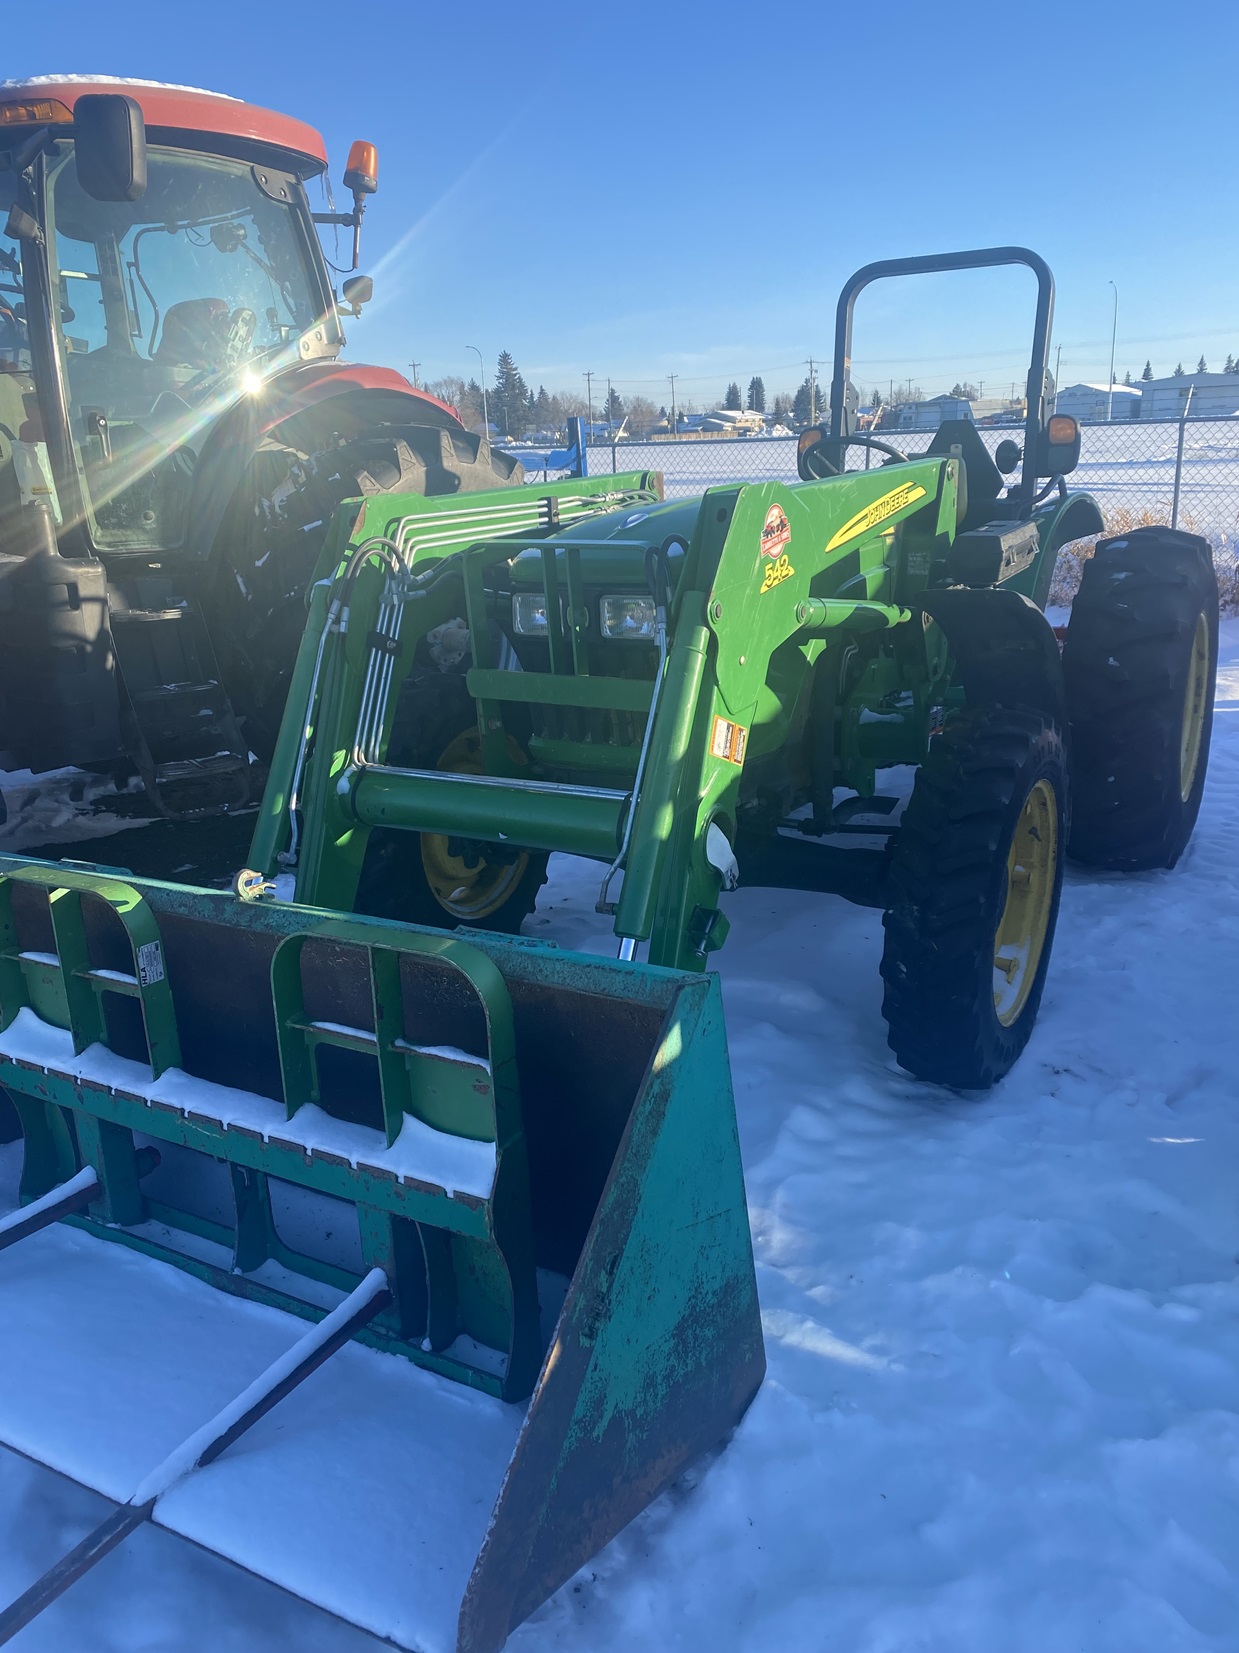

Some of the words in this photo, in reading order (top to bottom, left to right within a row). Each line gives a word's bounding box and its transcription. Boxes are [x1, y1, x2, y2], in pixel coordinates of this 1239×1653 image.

[865, 501, 886, 527] JOHN
[885, 488, 909, 515] DEERE
[765, 555, 789, 589] 542
